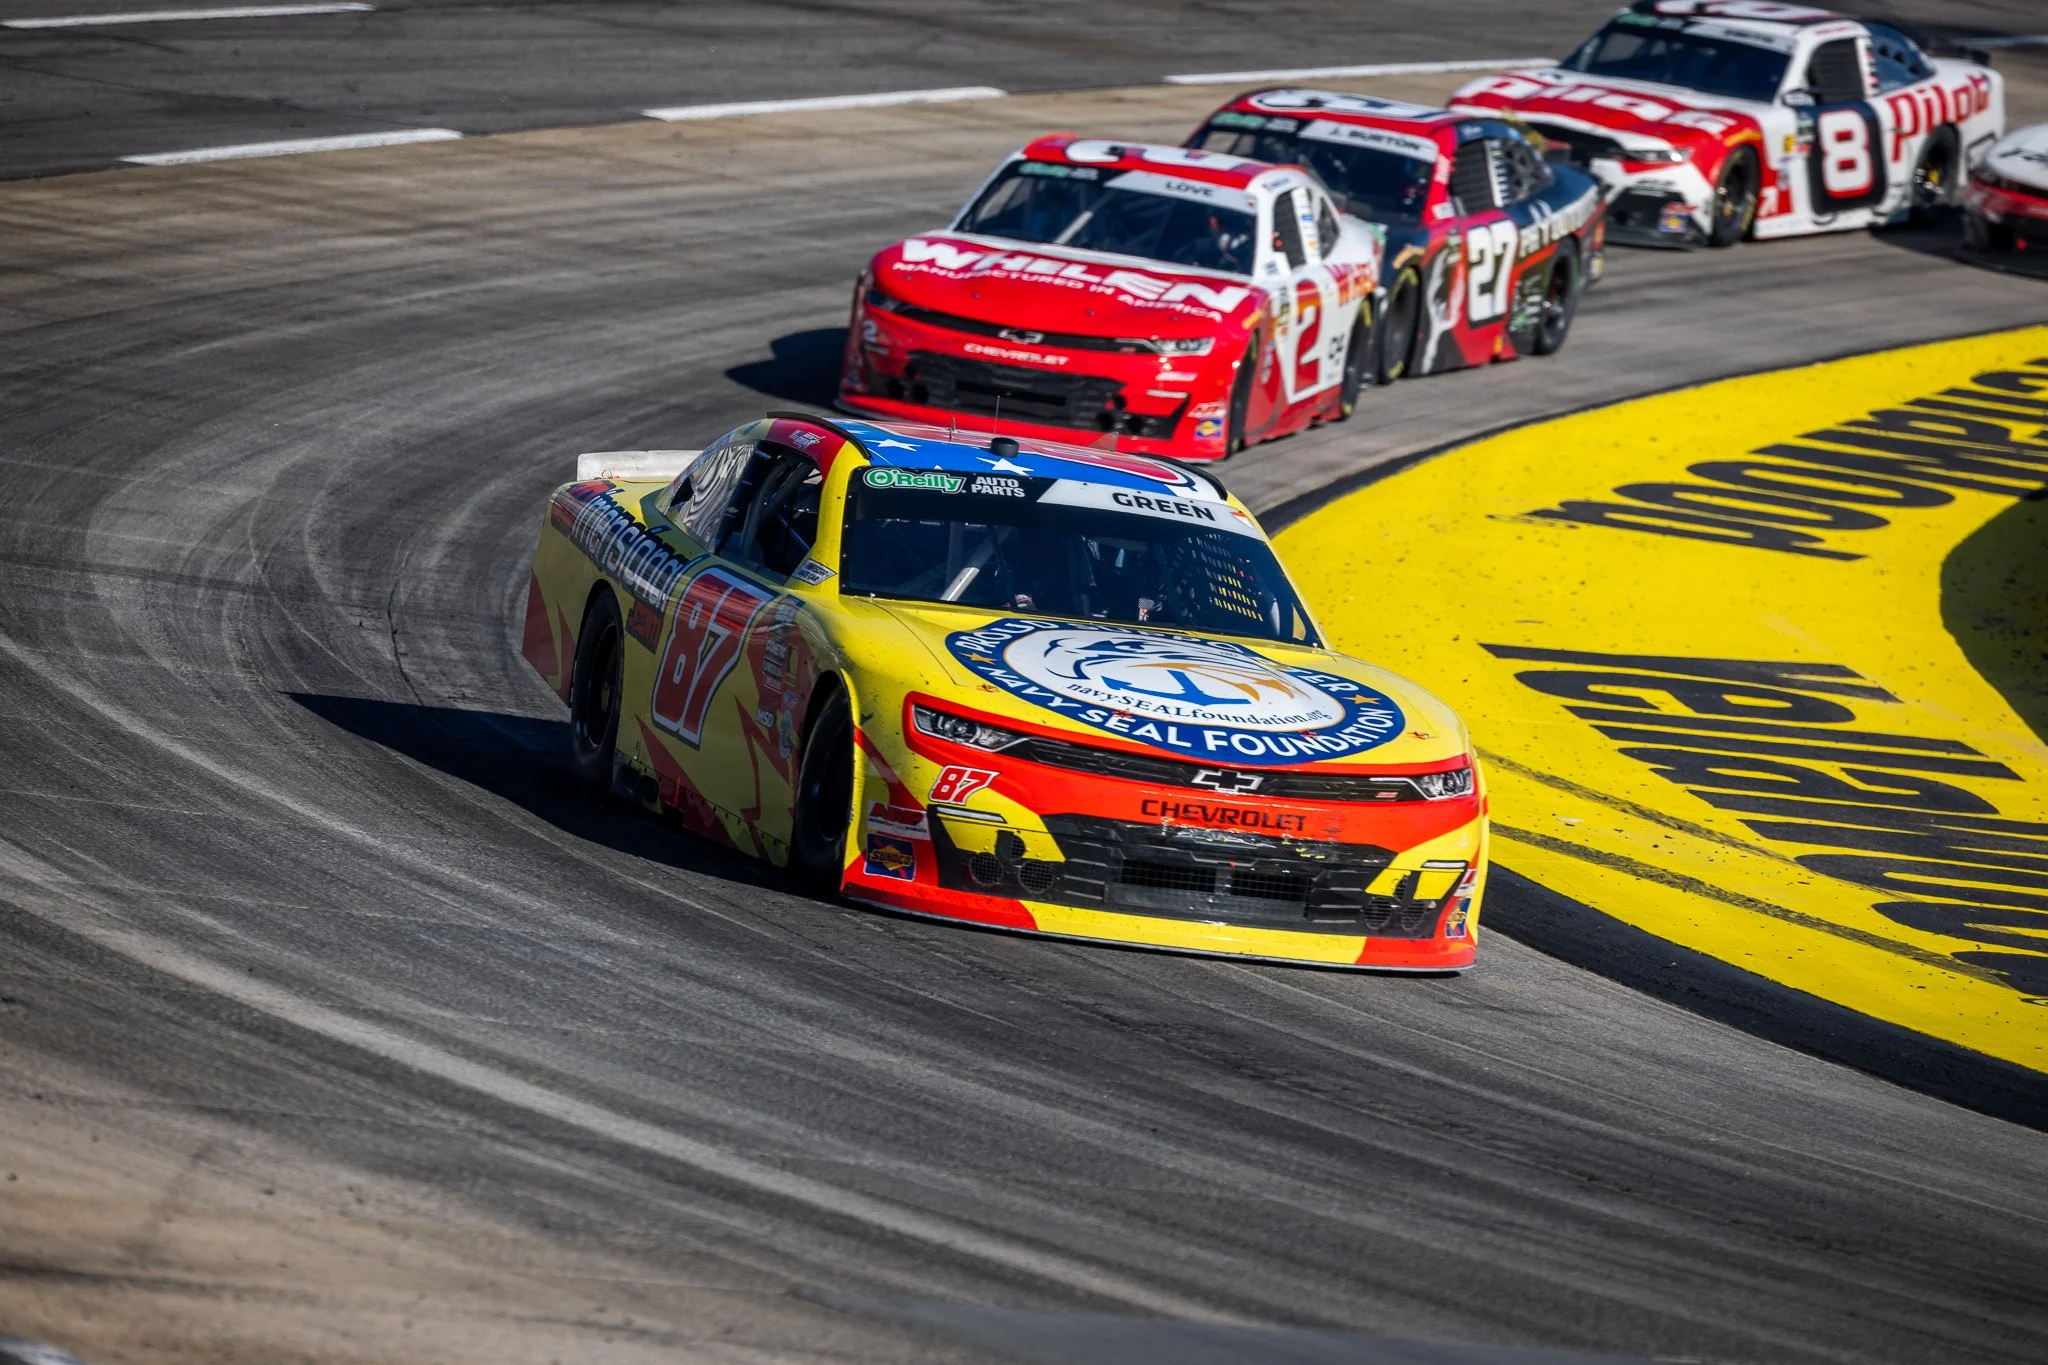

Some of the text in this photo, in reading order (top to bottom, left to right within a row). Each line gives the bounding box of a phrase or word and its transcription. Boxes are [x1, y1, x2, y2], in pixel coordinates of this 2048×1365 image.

[1347, 129, 1422, 151] BURTON
[1818, 109, 1874, 199] 8
[1165, 181, 1214, 197] LOVE
[901, 239, 1252, 314] WHELEN
[1466, 219, 1519, 324] 27
[892, 261, 1224, 323] MANUFACTURED IN AMERICA
[862, 320, 878, 343] 2
[1294, 278, 1321, 395] 2
[963, 343, 1070, 366] CHEVROLET
[866, 469, 962, 491] O'Reilly
[971, 484, 1026, 498] PARTS
[975, 476, 1020, 488] AUTO
[1112, 492, 1216, 521] GREEN
[955, 620, 1060, 653] PROUD
[653, 567, 775, 746] 87
[977, 666, 1396, 757] NAVY SEAL FOUNDATION
[1066, 683, 1333, 726] navySEALfoundation.org
[929, 764, 1001, 806] 87
[1141, 799, 1307, 831] CHEVROLET
[869, 849, 913, 867] SUNOCO
